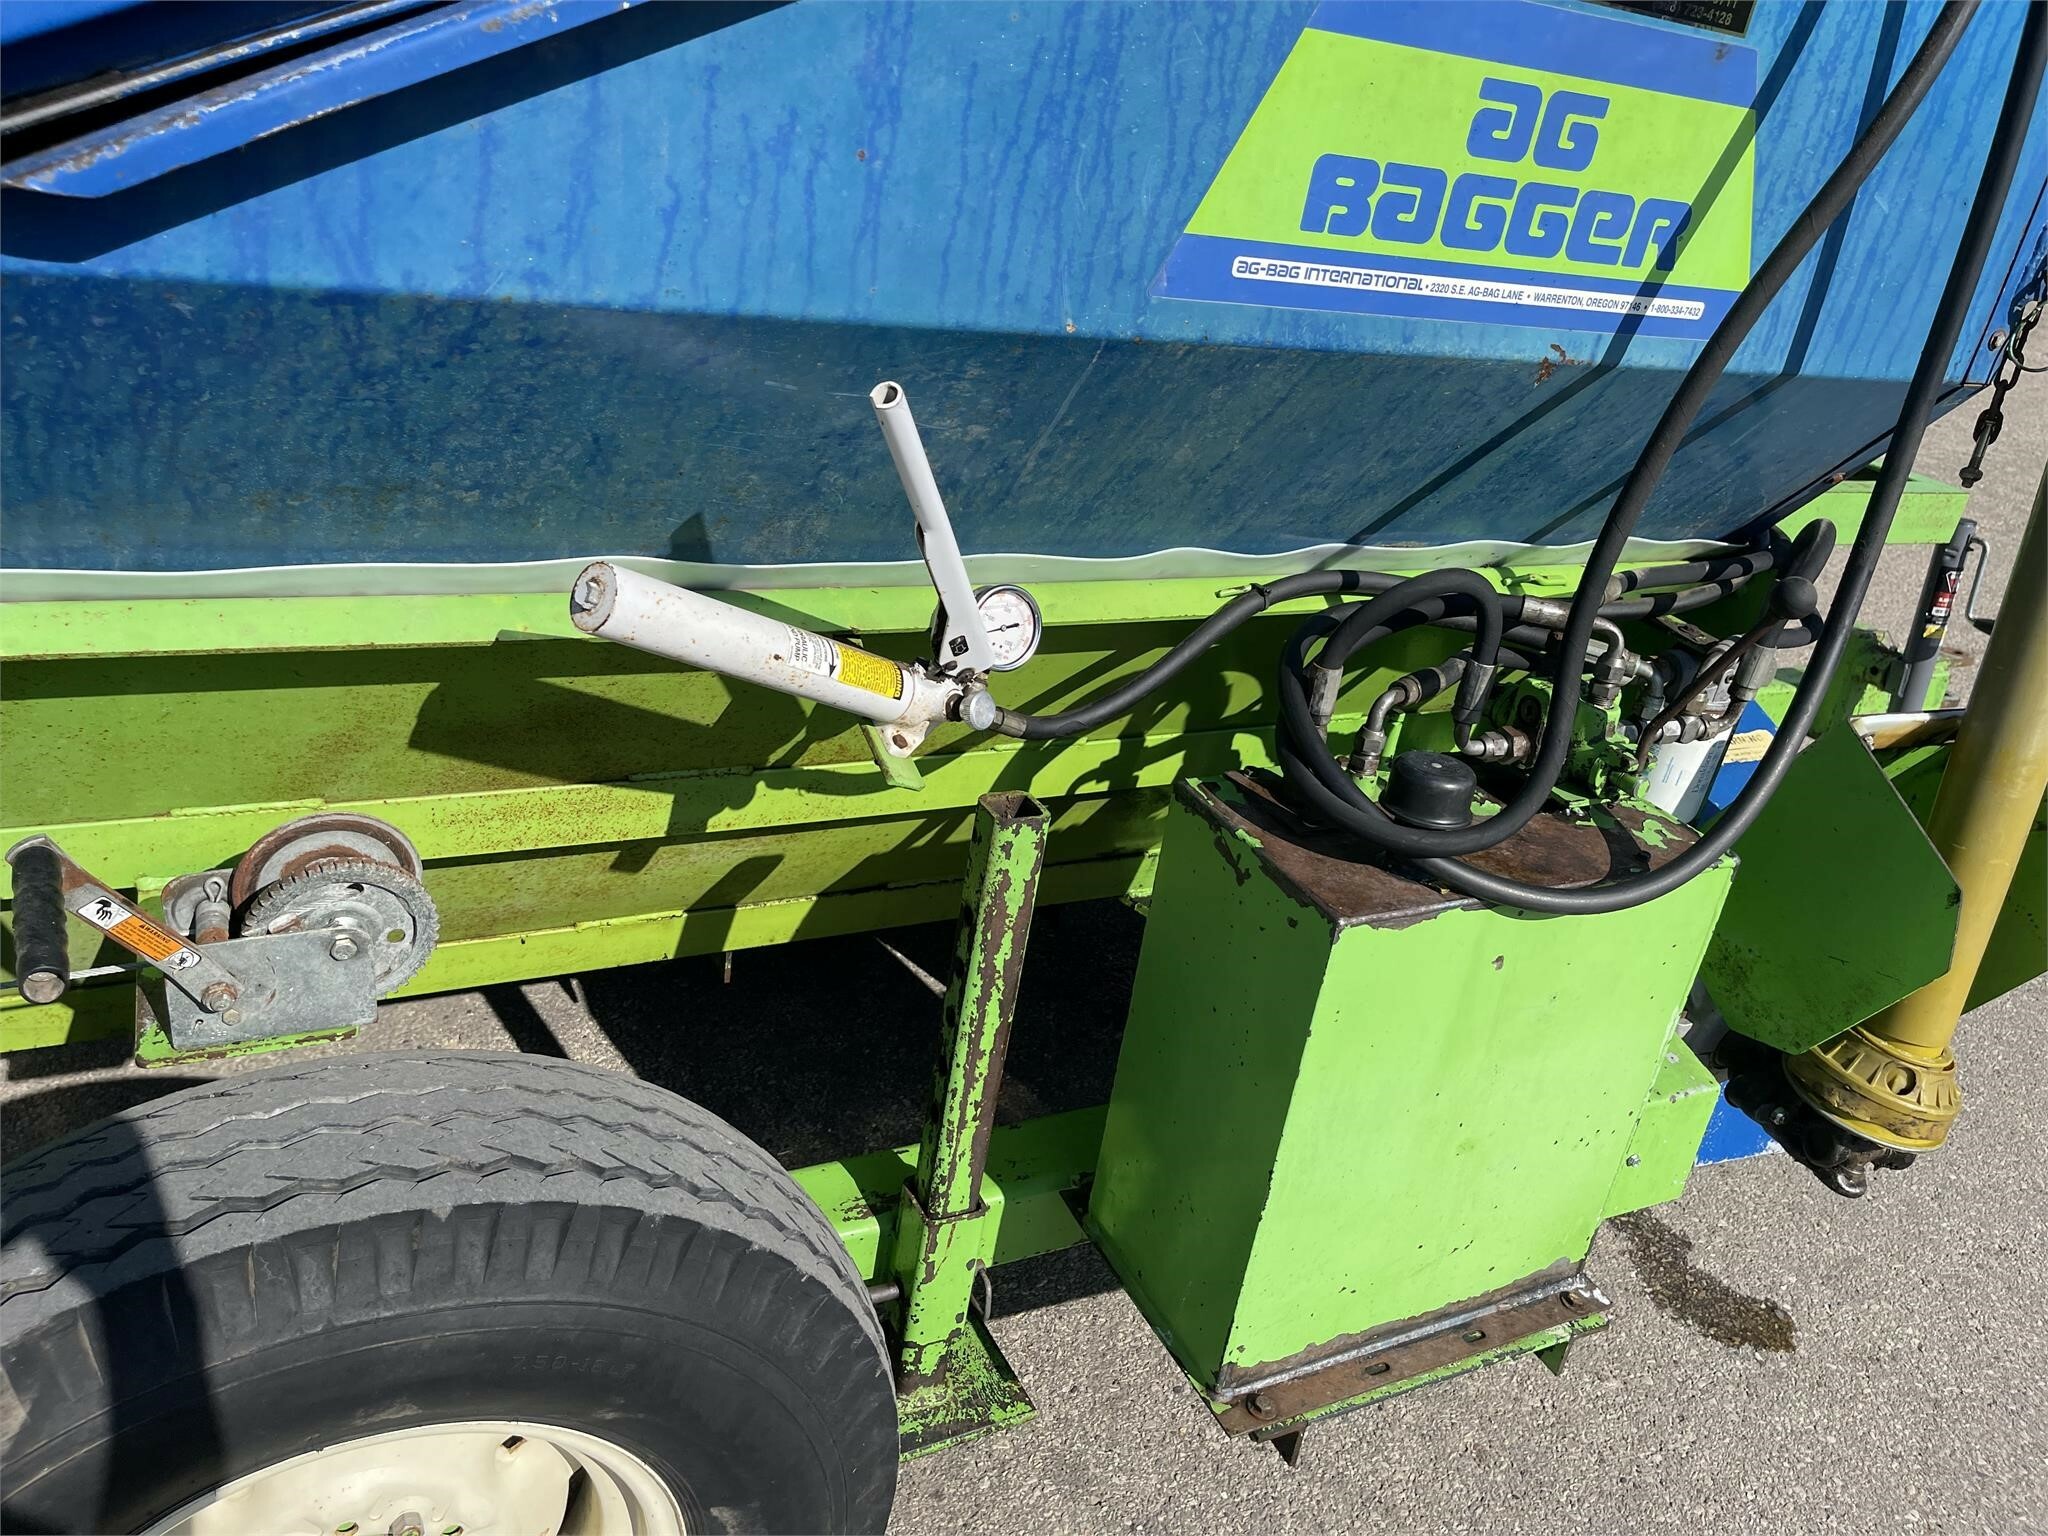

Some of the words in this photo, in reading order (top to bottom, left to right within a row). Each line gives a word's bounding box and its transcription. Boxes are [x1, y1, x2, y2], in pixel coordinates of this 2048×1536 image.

[1466, 77, 1610, 172] AG
[1300, 153, 1692, 271] BAGGER
[1236, 260, 1301, 279] AG-BAG
[1304, 267, 1423, 291] INTERNATIONAL
[1430, 282, 1449, 294] 2320
[1450, 284, 1466, 295] S.E.
[1468, 286, 1500, 299] AG-BAG
[1501, 289, 1524, 301] LANE
[1533, 292, 1584, 307] WARRENTON,
[1585, 297, 1619, 310] OREGON
[1651, 304, 1701, 317] 1-800-334-7432
